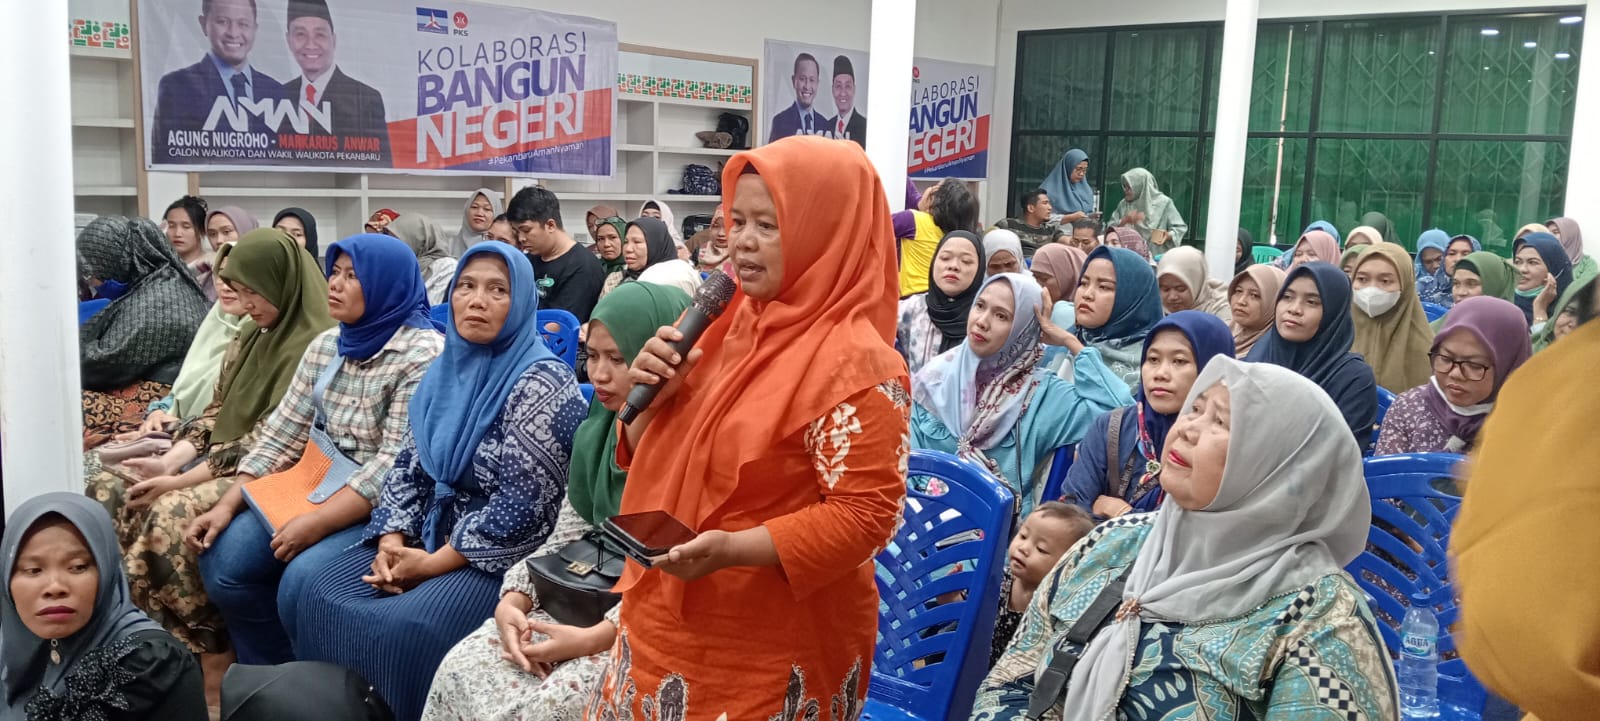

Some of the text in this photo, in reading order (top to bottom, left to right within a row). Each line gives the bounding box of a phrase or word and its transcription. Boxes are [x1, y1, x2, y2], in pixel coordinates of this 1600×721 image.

[418, 31, 586, 73] KOLABORASI
[417, 54, 586, 116] BANGUN
[911, 75, 979, 106] LABORASI
[202, 95, 332, 134] AMAN
[416, 91, 585, 164] NEGERI
[909, 91, 978, 134] ANGUN
[168, 130, 209, 147] AGUNG
[213, 132, 268, 148] NUGROHO
[279, 134, 339, 151] MARKARIUS
[344, 136, 381, 152] ANWAR
[169, 148, 381, 161] CALON WALIKOTA DAN WAKIL WALIKOTA PEKANBARU
[488, 142, 584, 166] #PekanbaruAmanNyaman
[908, 118, 977, 168] EGERI
